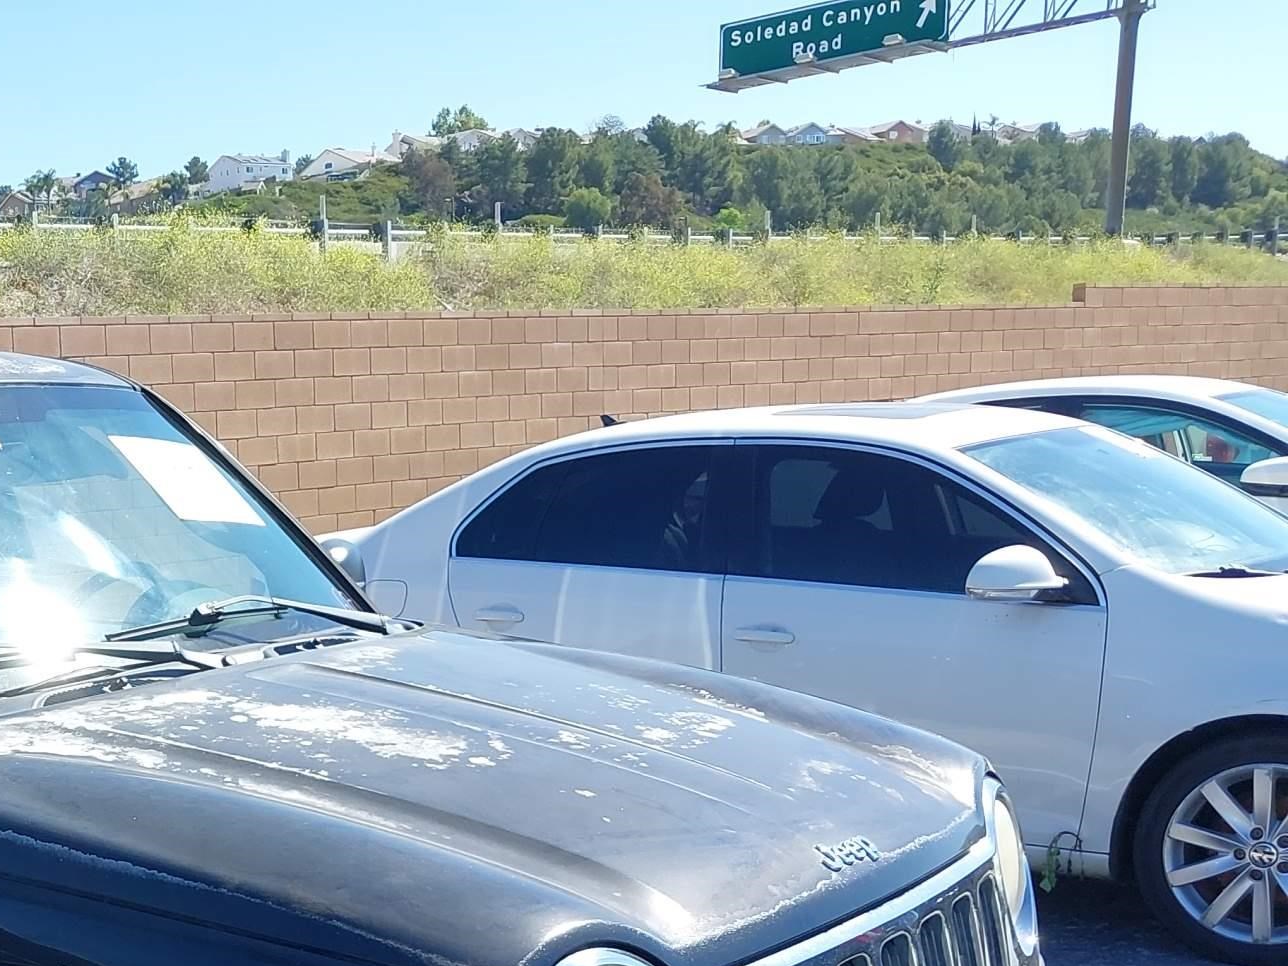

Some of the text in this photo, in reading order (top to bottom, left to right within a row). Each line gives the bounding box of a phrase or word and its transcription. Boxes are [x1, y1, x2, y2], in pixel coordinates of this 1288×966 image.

[730, 0, 901, 47] Soledad Canyon
[792, 33, 842, 59] Road
[813, 836, 879, 872] Jeep
